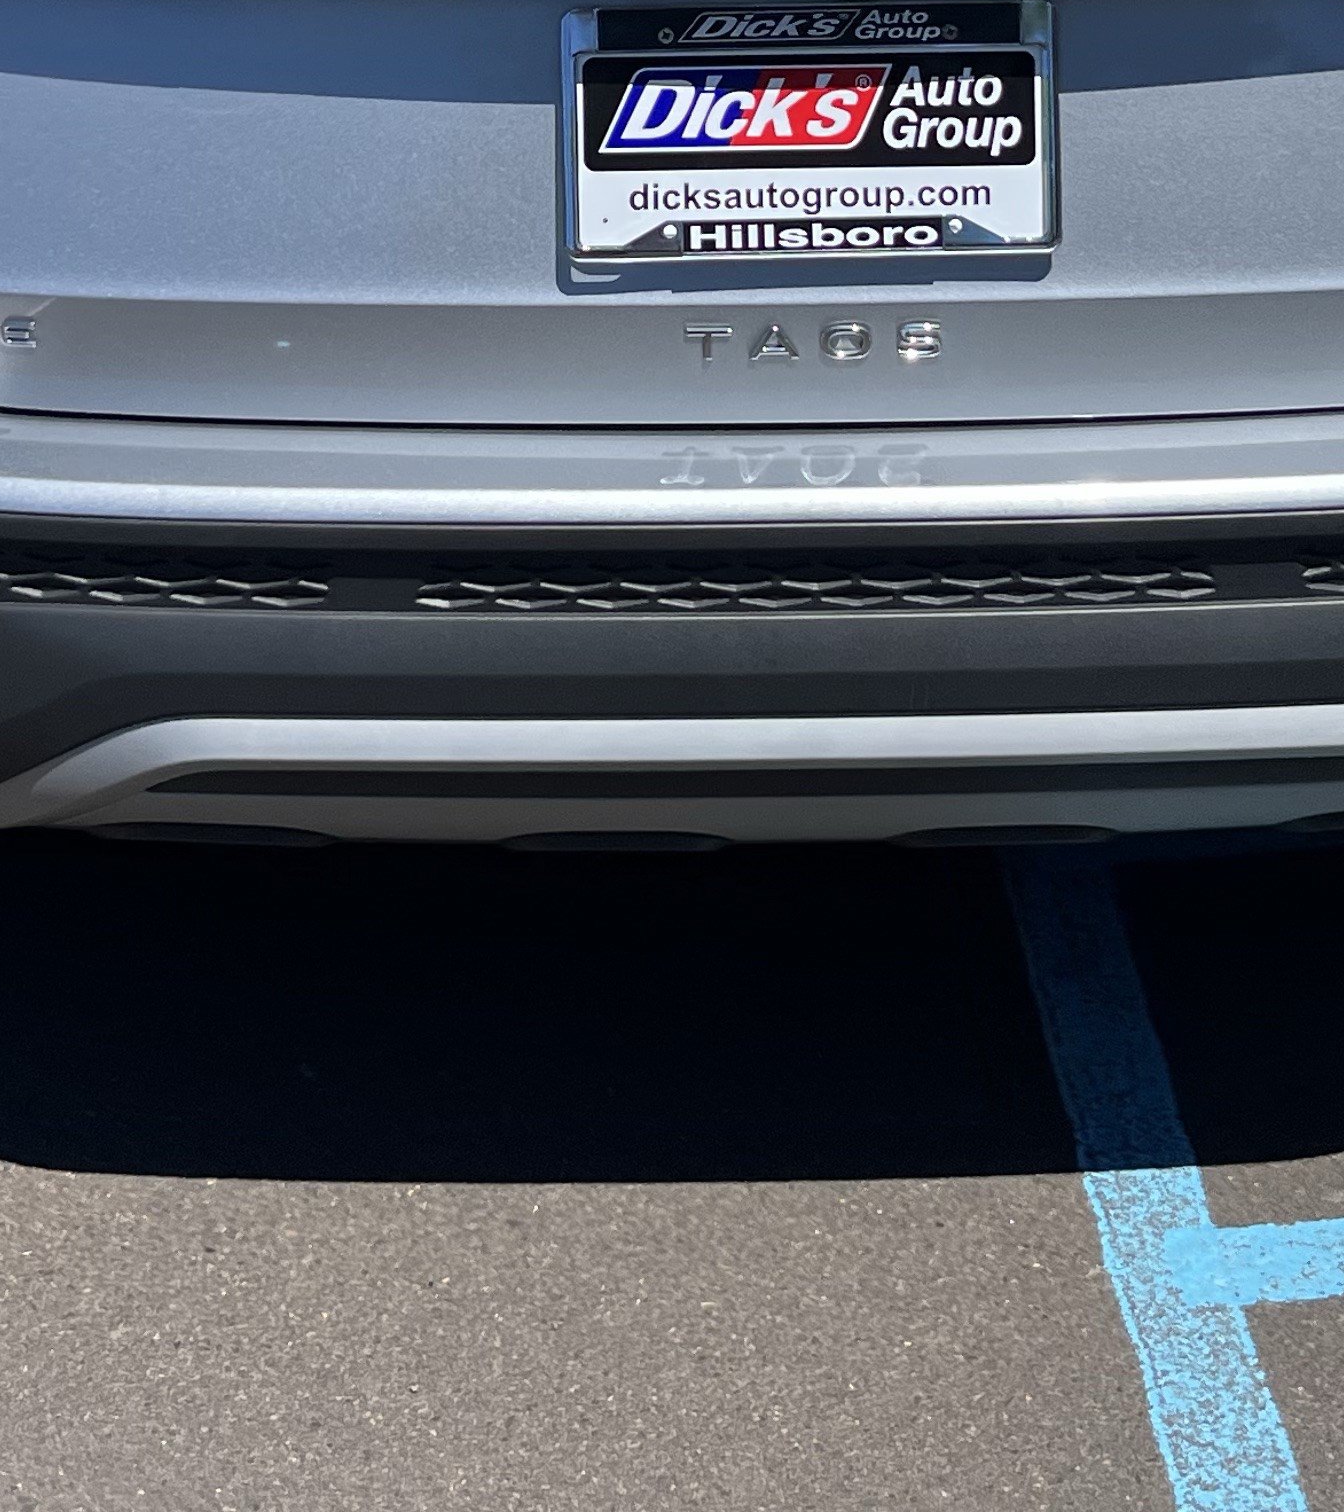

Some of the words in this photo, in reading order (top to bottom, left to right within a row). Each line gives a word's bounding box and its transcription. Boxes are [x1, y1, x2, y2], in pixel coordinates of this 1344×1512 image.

[855, 23, 942, 41] Group
[861, 8, 929, 25] Auto
[889, 65, 1003, 107] Auto
[621, 74, 860, 141] Dick's
[882, 107, 1022, 157] Group
[628, 181, 992, 215] dicksautogroup.com
[689, 221, 939, 250] Hillsboro
[684, 319, 943, 361] TAOS
